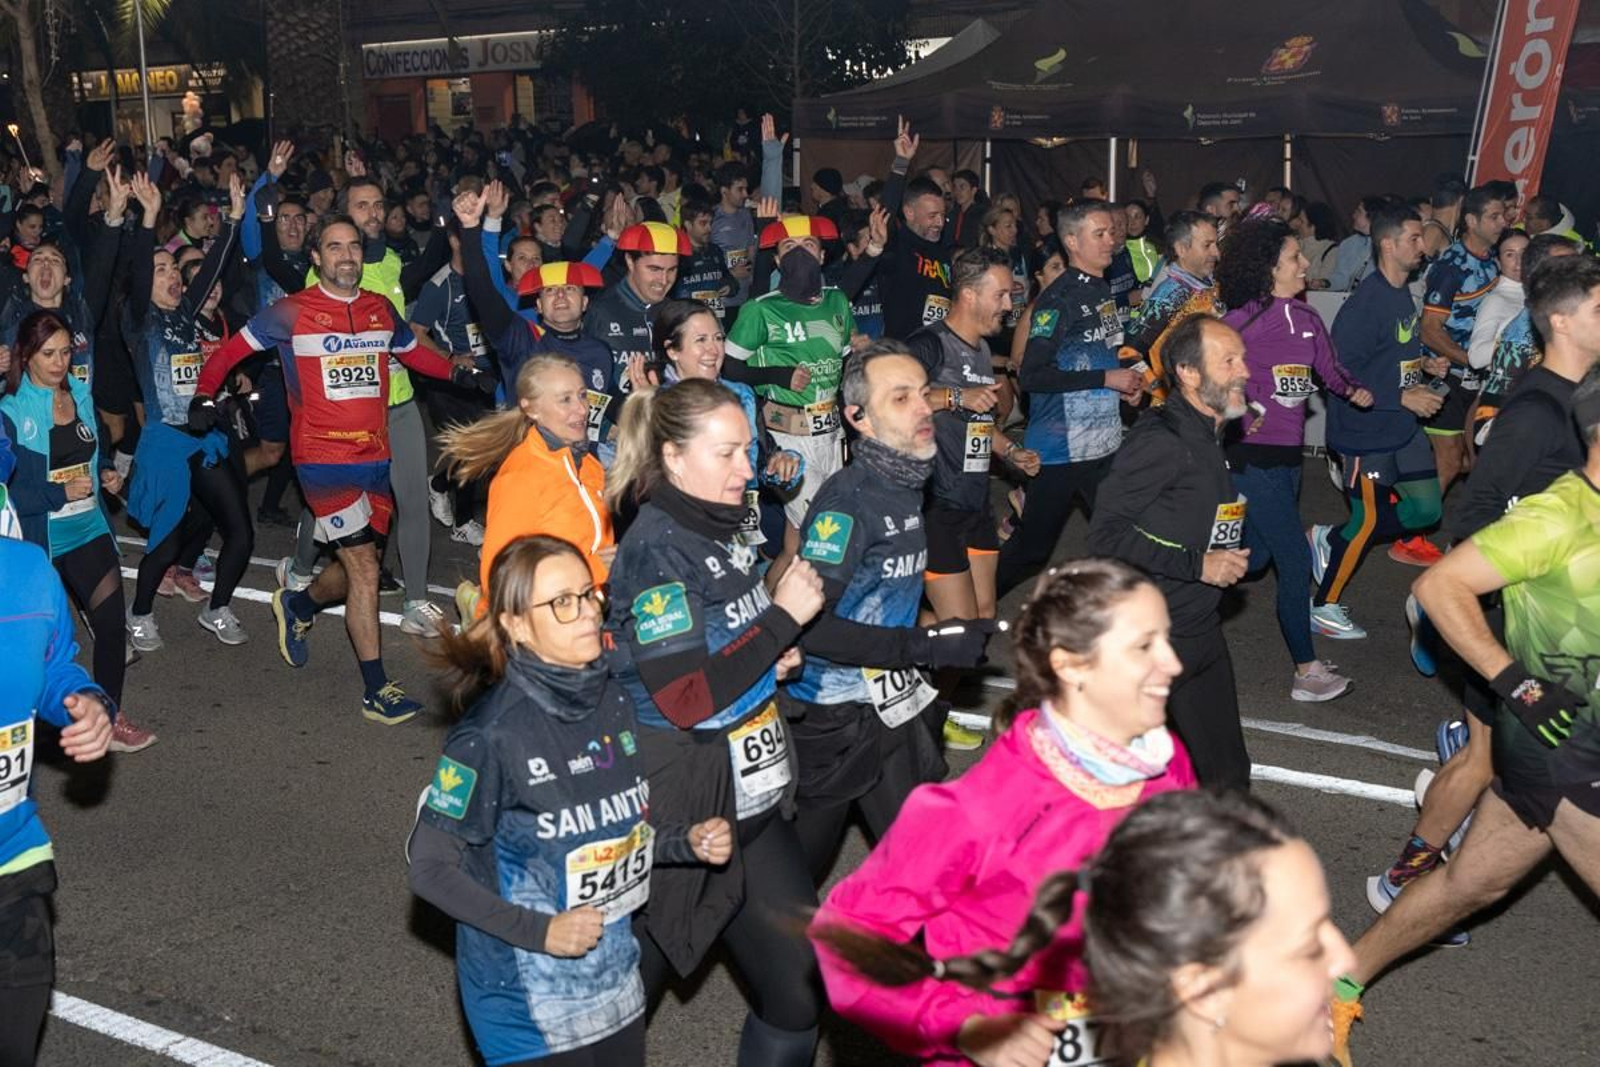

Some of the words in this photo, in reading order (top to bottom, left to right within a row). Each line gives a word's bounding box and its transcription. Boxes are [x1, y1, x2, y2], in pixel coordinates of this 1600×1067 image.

[365, 46, 470, 77] CONFECCIONS
[683, 275, 701, 285] SAN
[852, 305, 870, 315] SAN
[784, 321, 806, 343] 14
[343, 338, 386, 349] Avanza
[328, 366, 376, 383] 9929
[589, 405, 602, 422] 7
[971, 437, 991, 453] 91
[1214, 521, 1240, 541] 86
[881, 554, 915, 579] SAN
[725, 592, 757, 629] SAN
[536, 803, 596, 839] SAN
[577, 844, 648, 901] 5415
